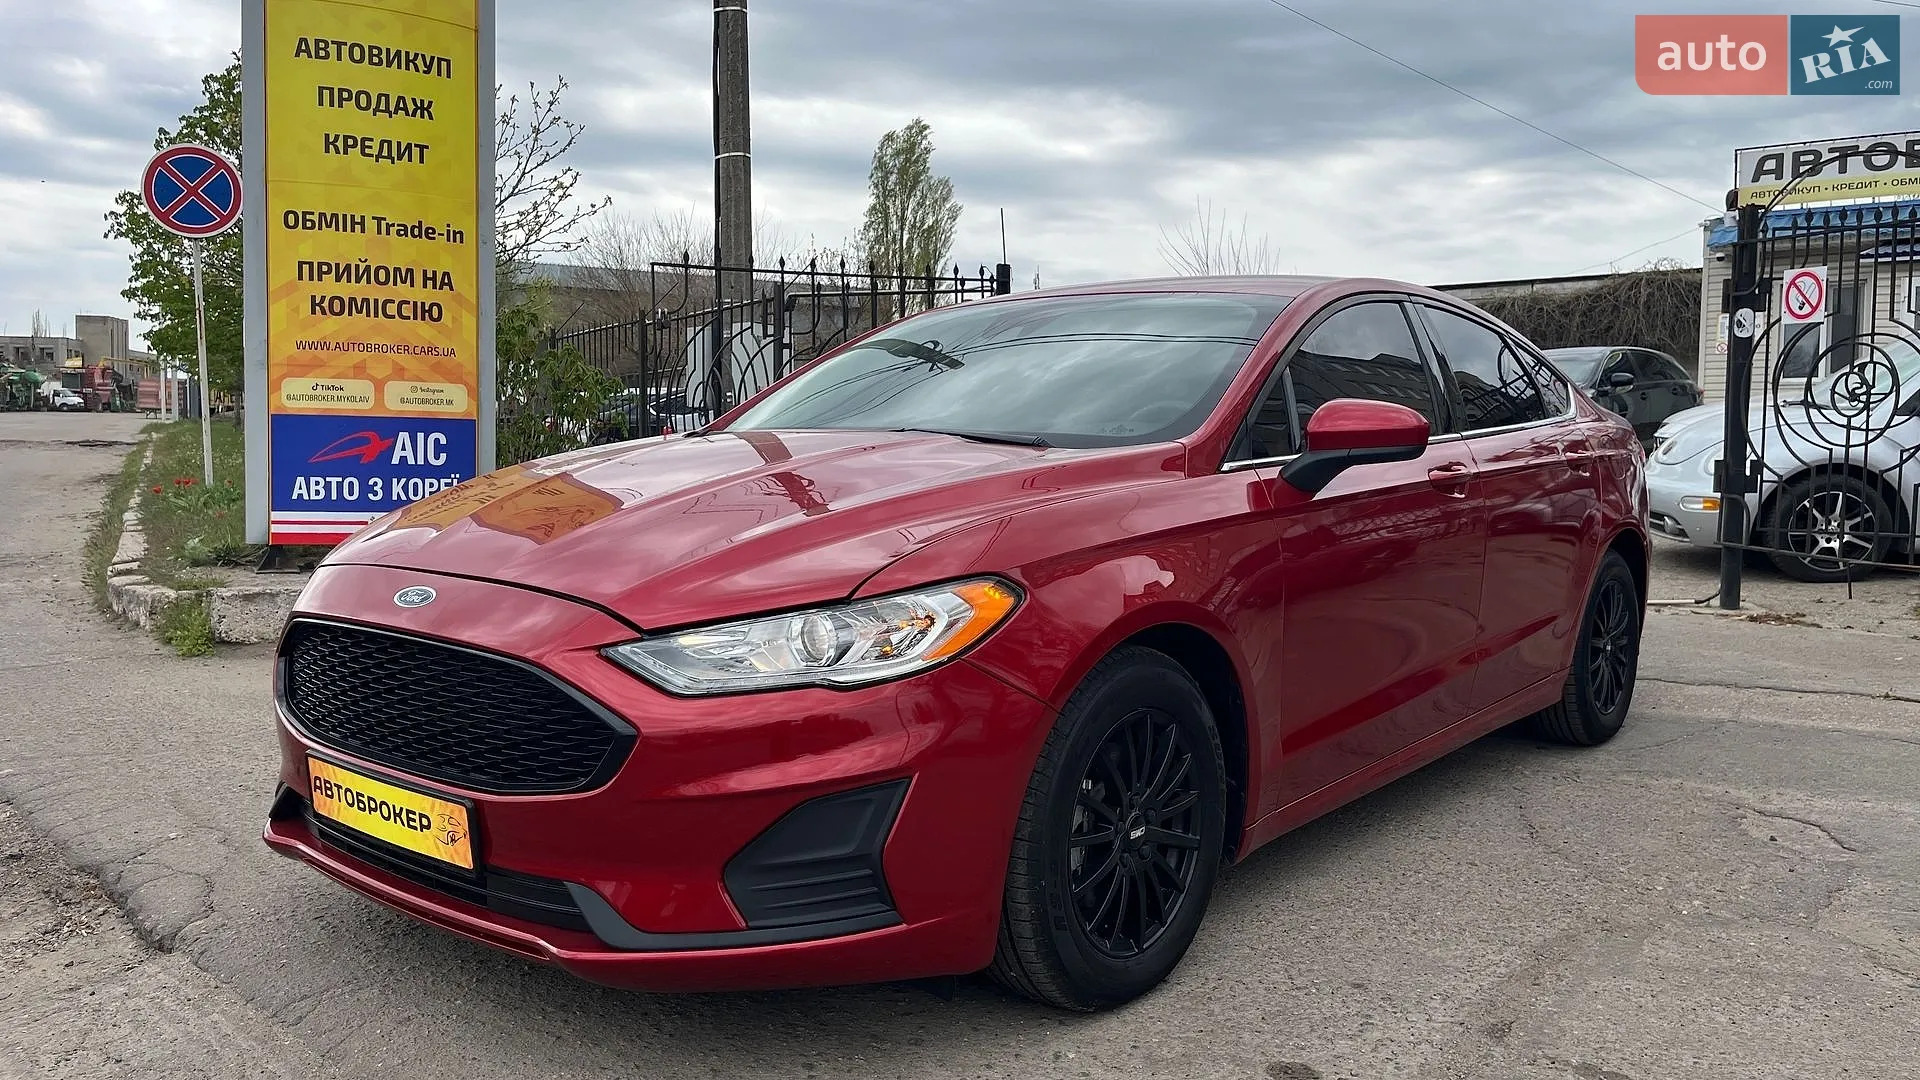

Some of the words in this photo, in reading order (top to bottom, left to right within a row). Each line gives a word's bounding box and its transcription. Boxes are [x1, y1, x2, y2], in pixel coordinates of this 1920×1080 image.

[294, 37, 452, 79] АВТОВИКУП
[317, 85, 435, 121] ПРОДАЖ
[323, 133, 430, 165] КРЕДИТ
[1832, 180, 1880, 192] КРЕДИТ
[1891, 177, 1920, 186] ОБМ
[283, 210, 366, 234] ОБМІН
[372, 216, 464, 244] Trade-in
[297, 258, 415, 288] ПРИЙОМ
[422, 269, 454, 292] НА
[310, 295, 443, 323] КОМІССІЮ
[295, 340, 457, 358] WWW.AUTOBROKER.CARS.UA
[286, 394, 370, 403] @AUTOBROKER.MYKOLAIV
[320, 384, 345, 392] TikTok
[292, 476, 360, 501] АВТО
[313, 775, 432, 832] АВТОБРОКЕР
